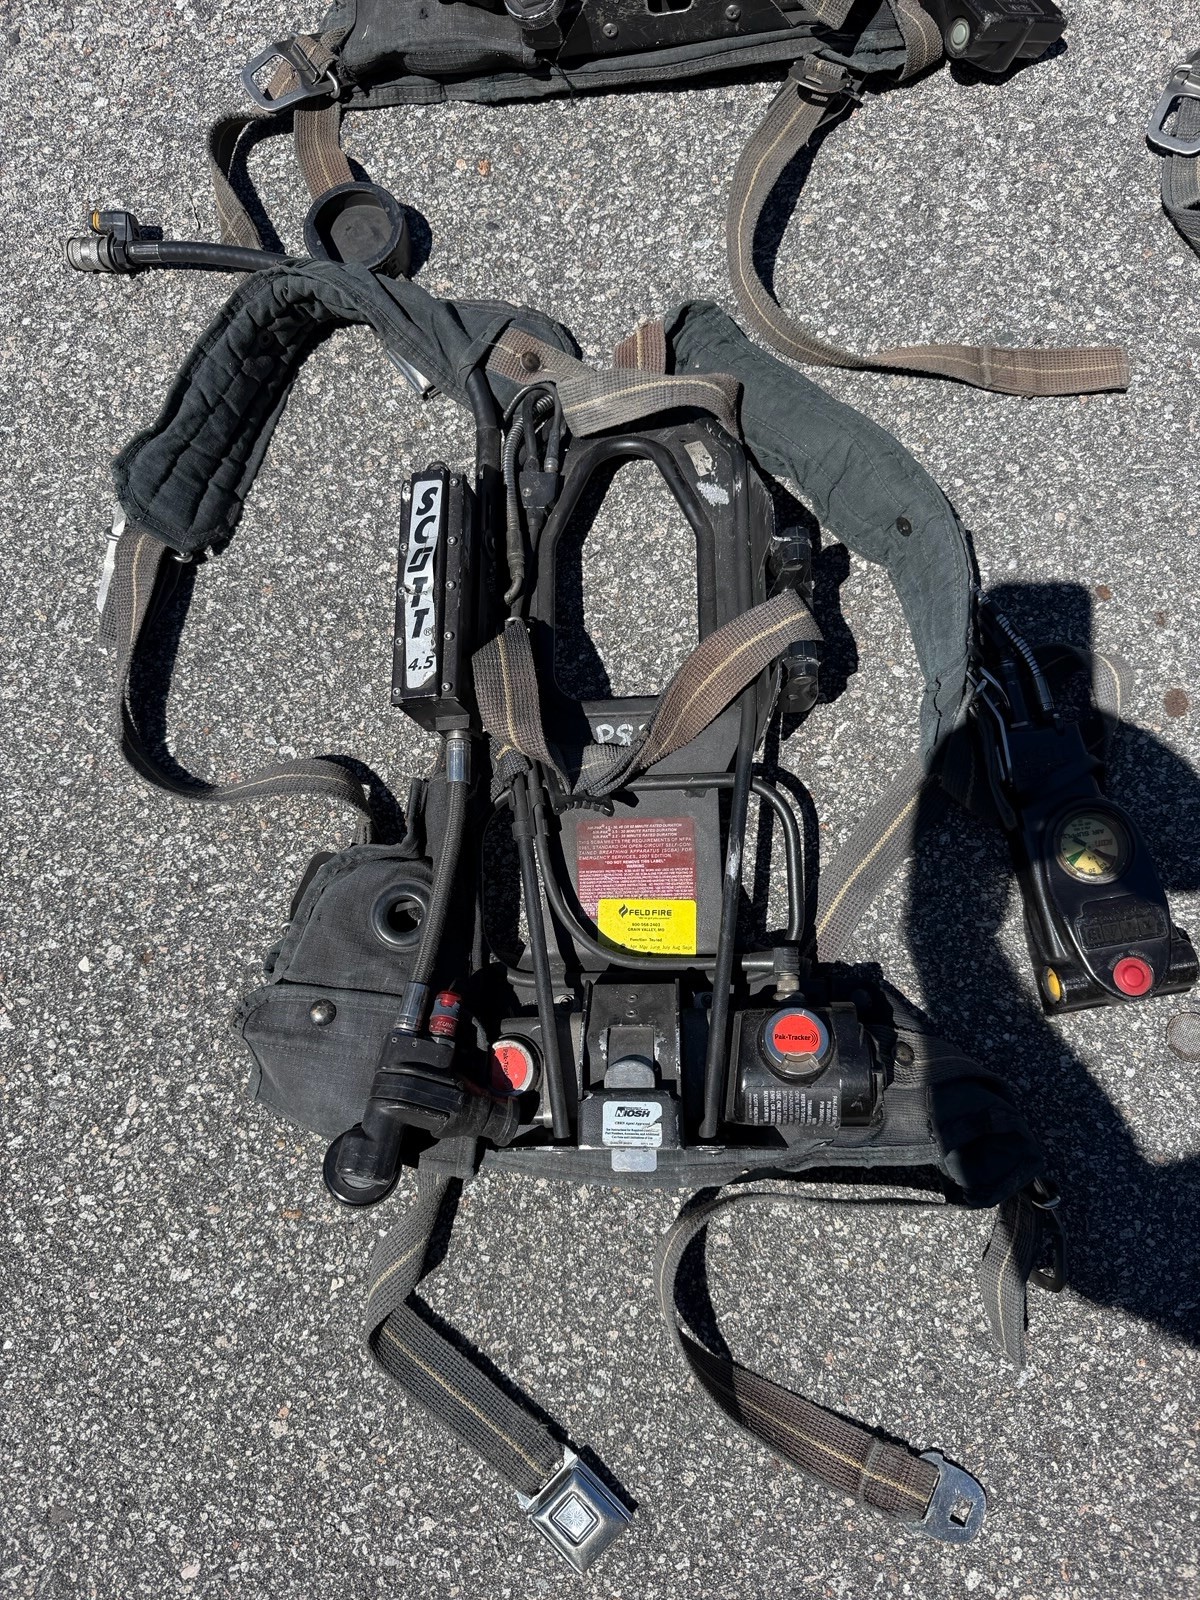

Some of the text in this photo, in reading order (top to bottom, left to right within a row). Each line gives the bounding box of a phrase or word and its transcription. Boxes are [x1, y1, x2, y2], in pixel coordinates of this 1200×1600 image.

[408, 655, 434, 672] 4.5
[1064, 830, 1089, 839] SUPPLY
[615, 1106, 651, 1117] NIOSH
